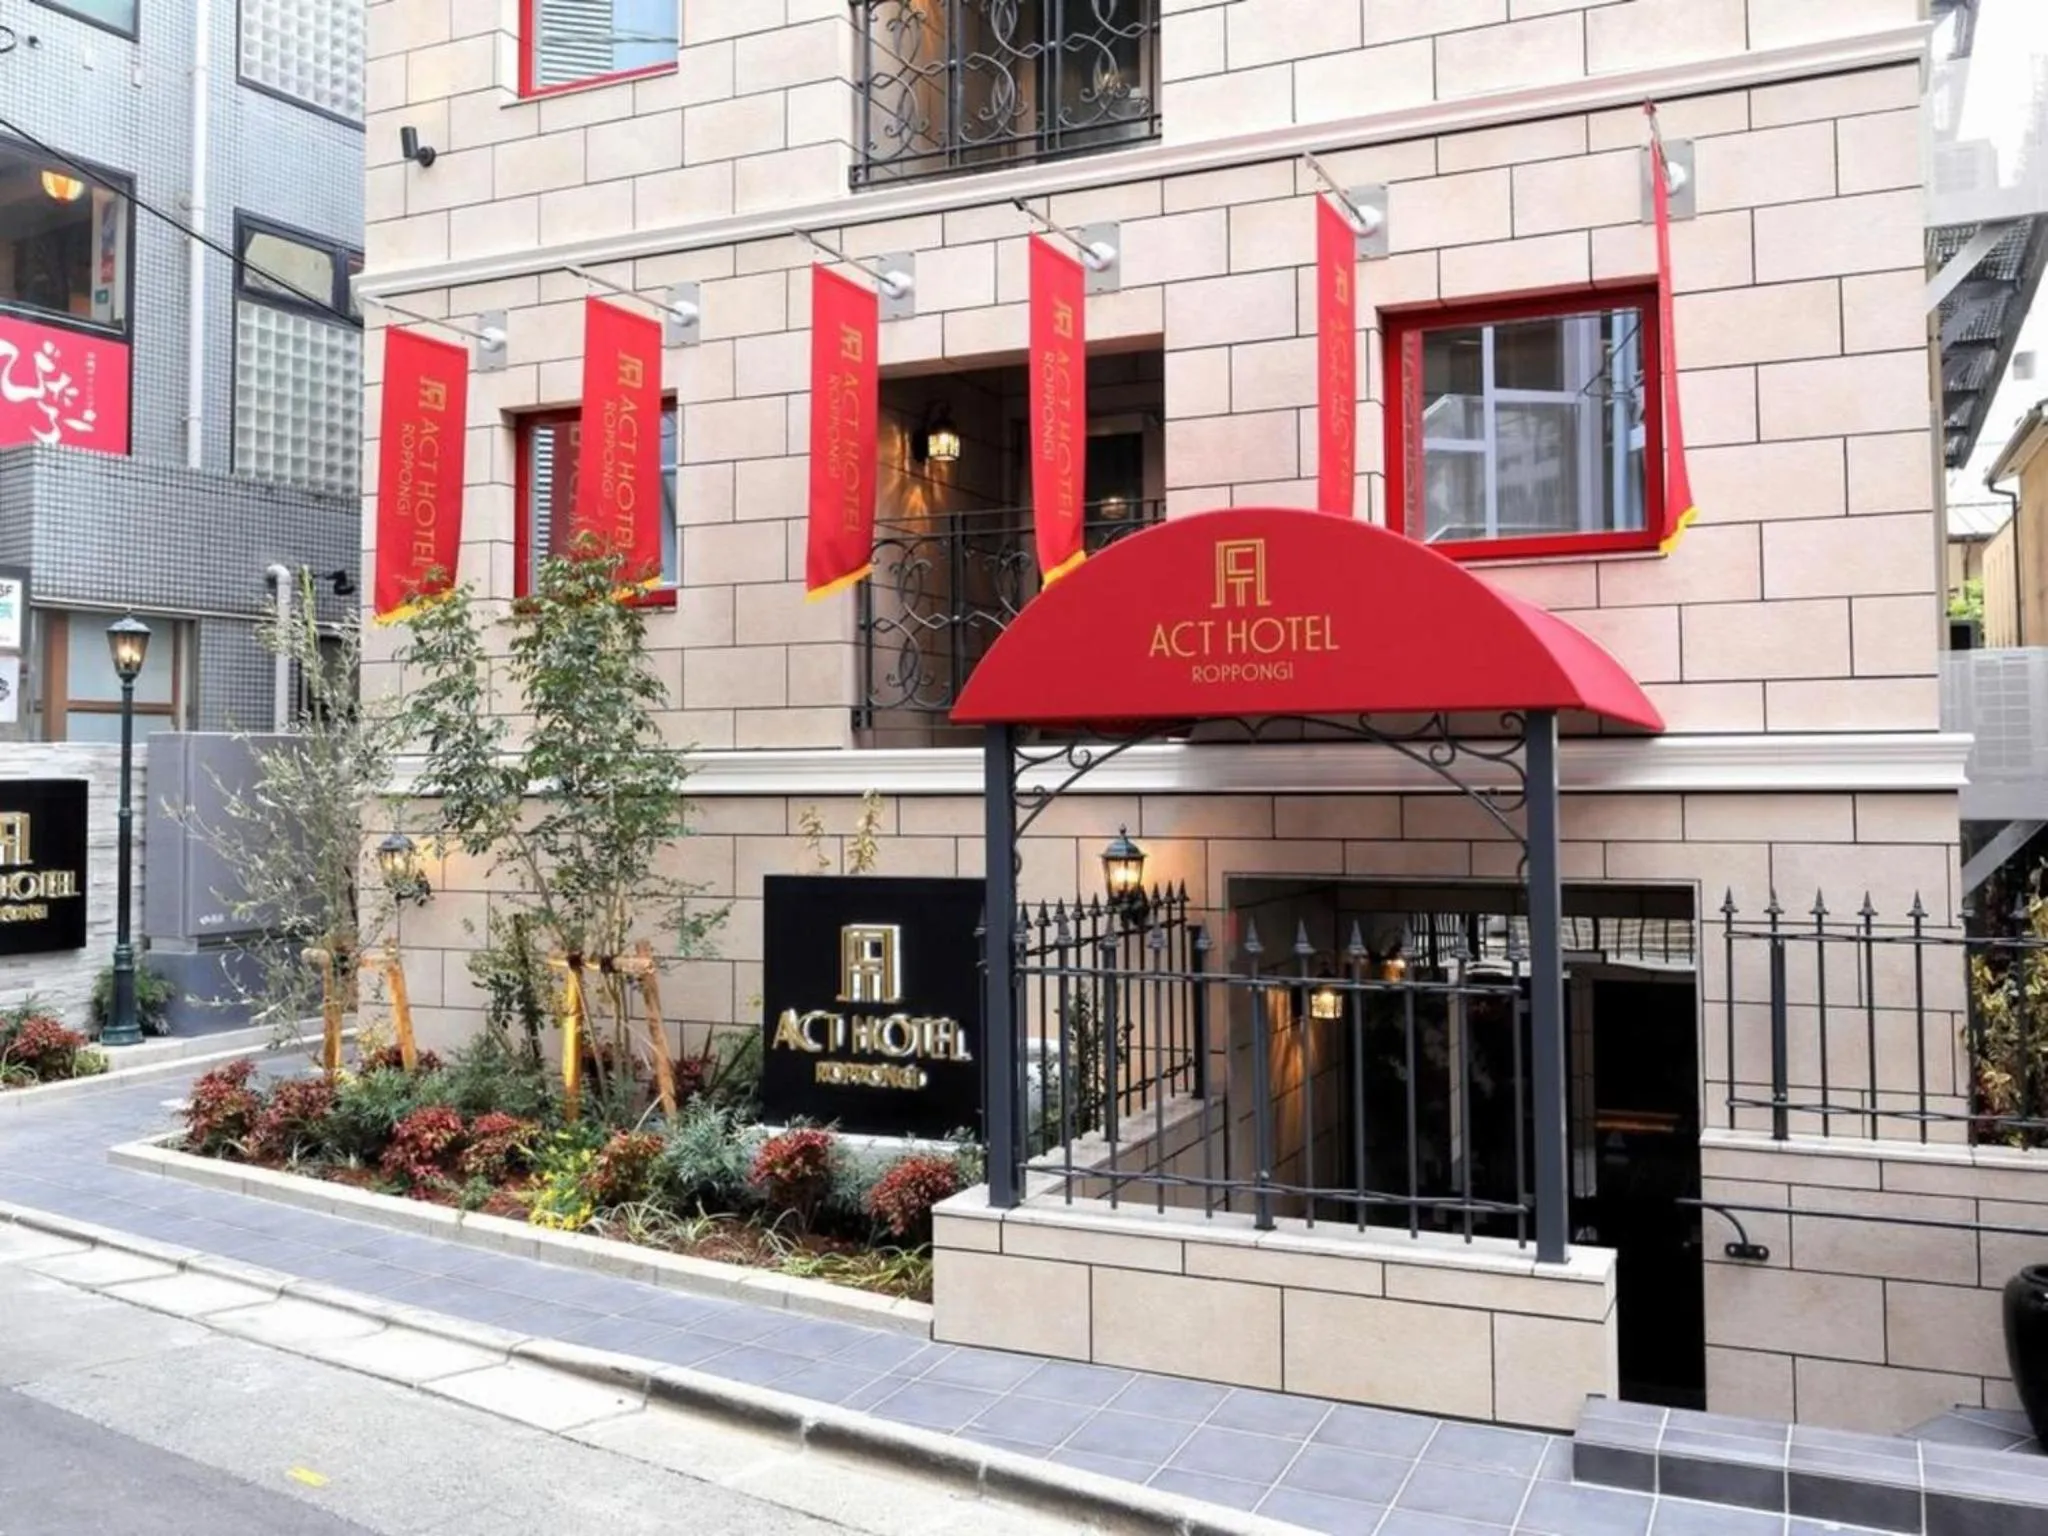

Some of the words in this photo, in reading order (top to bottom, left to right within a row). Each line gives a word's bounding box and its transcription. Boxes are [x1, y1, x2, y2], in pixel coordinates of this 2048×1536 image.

[418, 416, 441, 475] ACT
[617, 393, 639, 456] ACT
[396, 422, 416, 517] ROPPONGI
[411, 480, 438, 567] HOTEL
[614, 462, 636, 549] HOTEL
[1148, 620, 1215, 658] ACT
[1227, 615, 1340, 654] HOTEL
[1191, 661, 1294, 684] ROPPONGI
[771, 1007, 846, 1053] ACT
[852, 1012, 973, 1062] HOTEL
[815, 1060, 928, 1090] ROPPONGI
